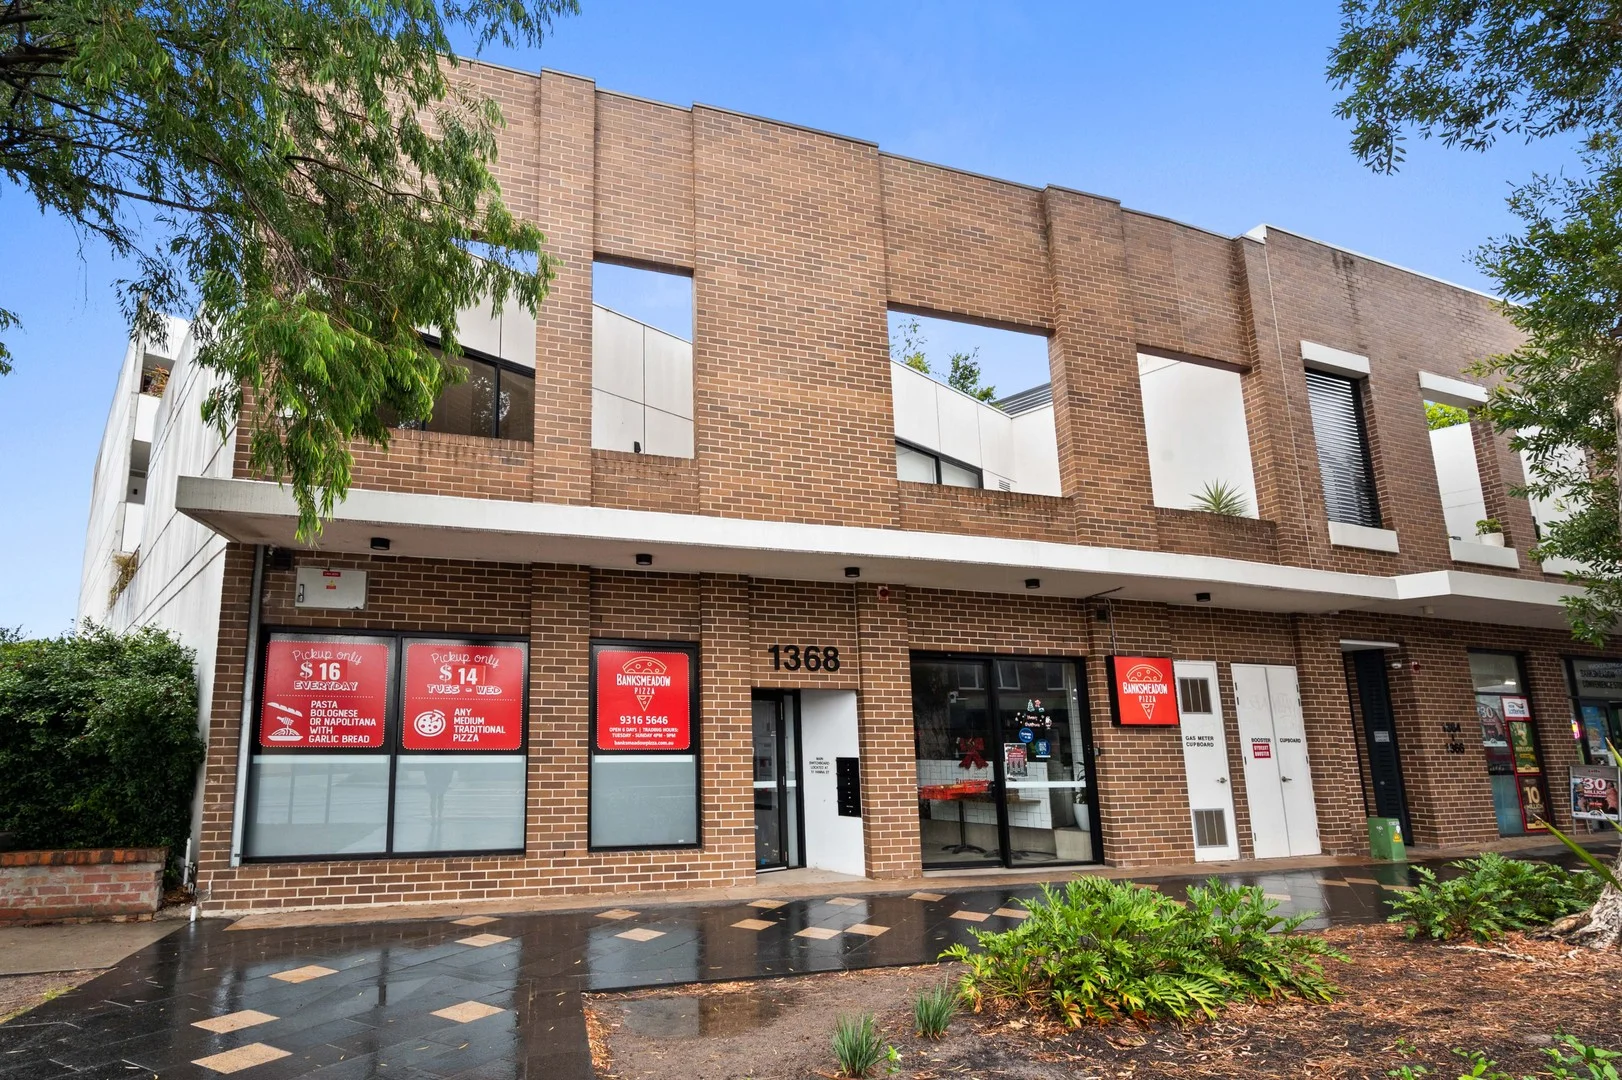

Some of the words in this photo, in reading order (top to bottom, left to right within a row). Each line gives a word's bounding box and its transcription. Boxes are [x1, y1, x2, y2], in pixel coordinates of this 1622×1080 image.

[292, 648, 332, 661] Pickup
[336, 651, 362, 665] only
[430, 651, 471, 664] Pickup
[474, 654, 499, 668] only
[768, 645, 840, 672] 1368
[300, 661, 313, 680] $
[319, 662, 341, 681] 16
[439, 664, 452, 682] $
[458, 667, 478, 685] 14
[616, 673, 671, 687] BANKSMEADOW
[294, 681, 358, 691] EVERYDAY
[427, 684, 460, 694] TUES
[476, 685, 502, 695] WED
[1122, 681, 1168, 695] BANKSMEADOW
[634, 687, 655, 695] PIZZA
[1138, 695, 1157, 703] PIZZA
[311, 700, 338, 709] PASTA
[310, 709, 358, 718] BOLOGNESE
[454, 708, 472, 716] ANY
[309, 718, 321, 726] OR
[324, 718, 376, 726] NAPOLITANA
[453, 717, 485, 725] MEDIUM
[619, 715, 643, 724] 9316
[645, 715, 668, 724] 5646
[309, 726, 333, 735] WITH
[454, 725, 506, 734] TRADITIONAL
[308, 735, 339, 743] GARLIC
[342, 735, 370, 743] BREAD
[453, 734, 479, 742] PIZZA
